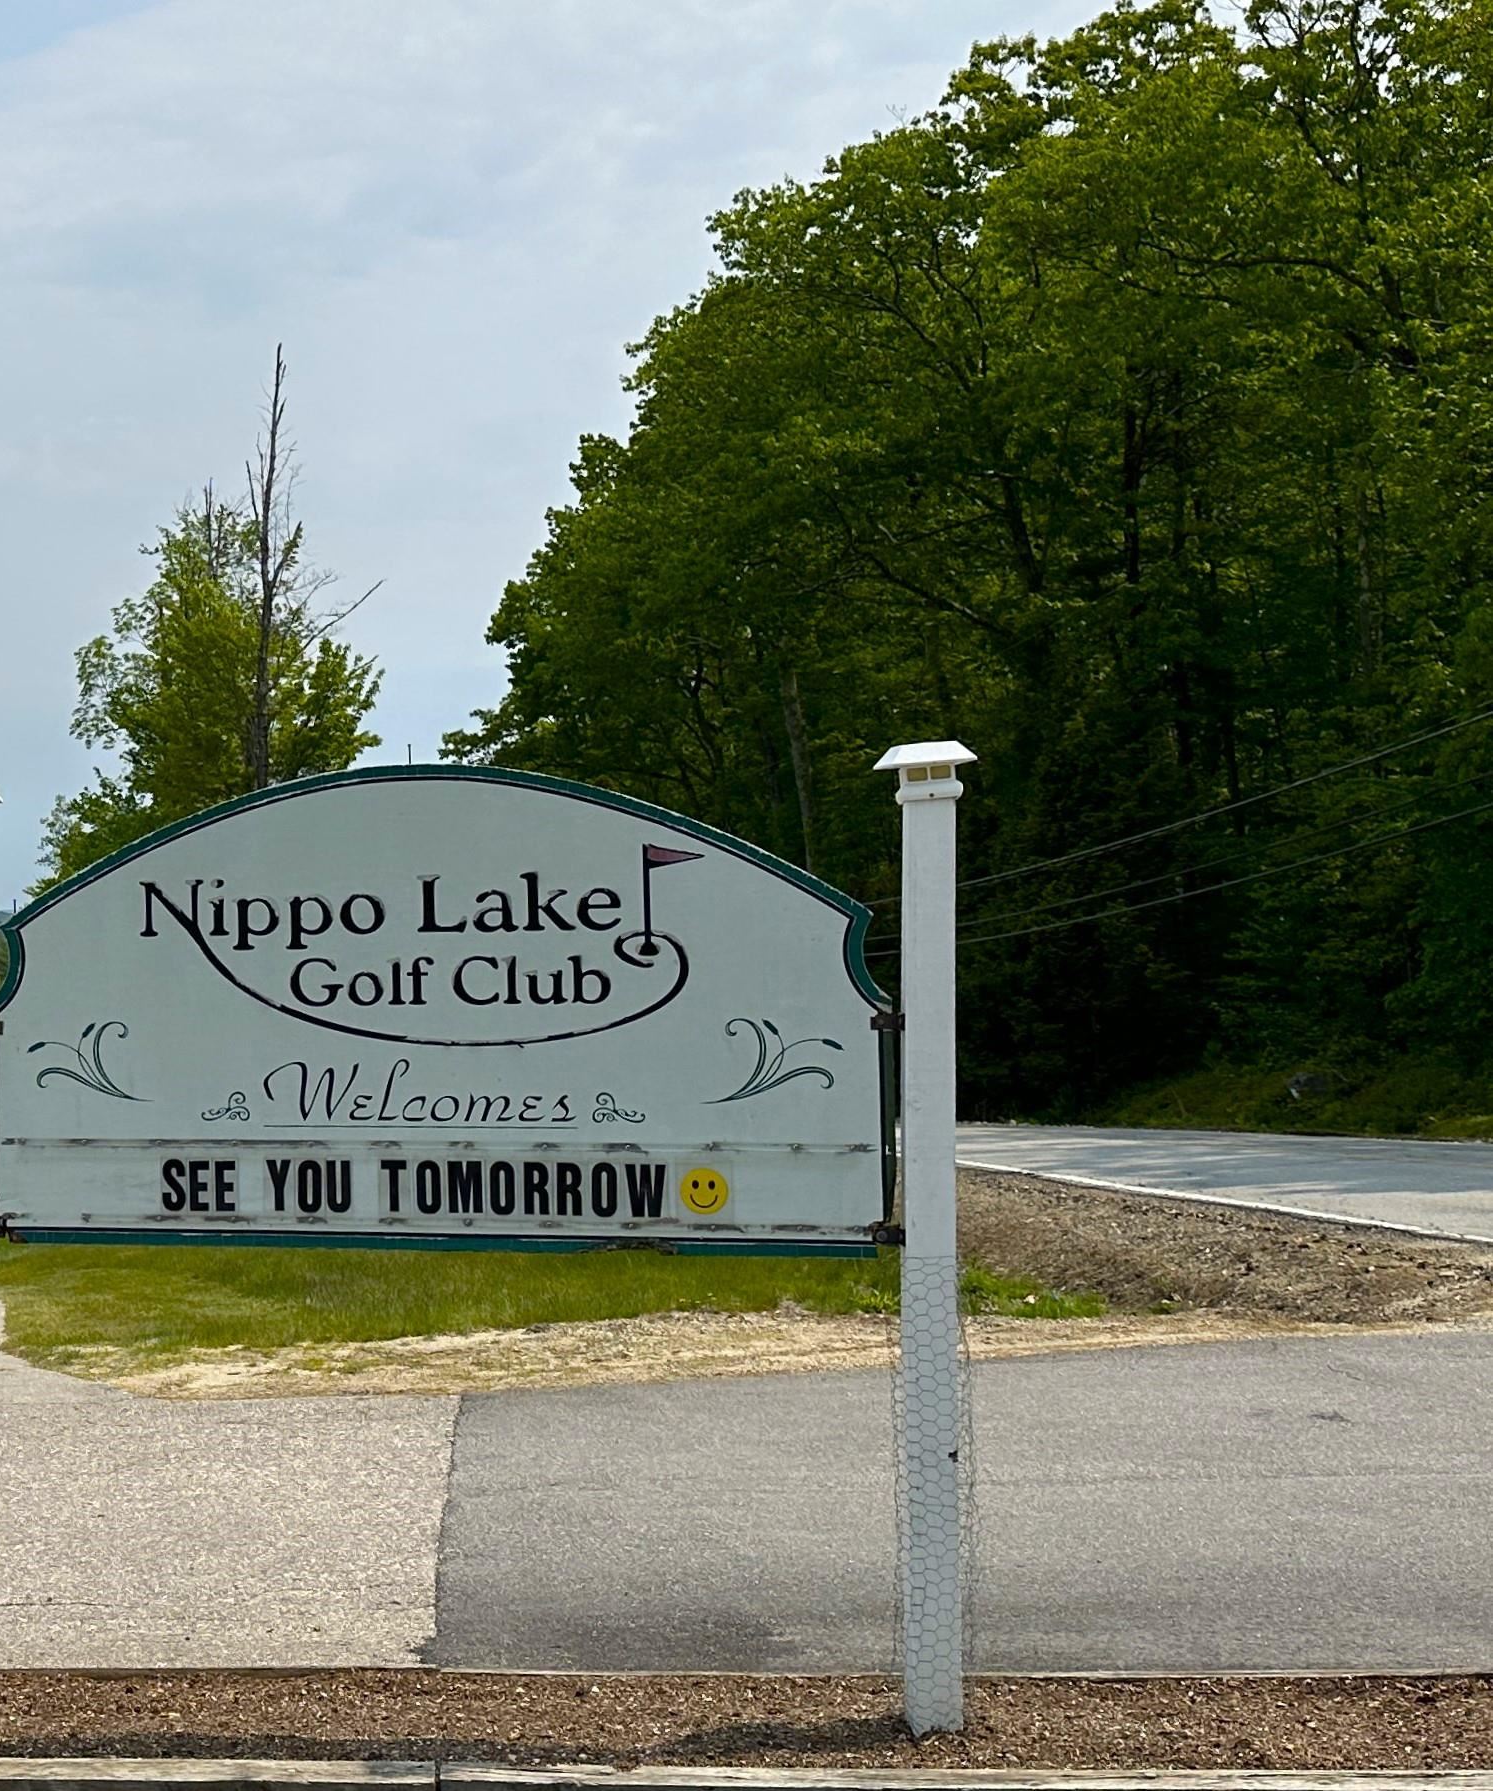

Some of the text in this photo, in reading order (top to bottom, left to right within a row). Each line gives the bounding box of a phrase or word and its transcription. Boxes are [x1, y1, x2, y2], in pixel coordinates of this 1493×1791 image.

[139, 871, 622, 951] Nippo Lake
[289, 955, 613, 1006] Golf Club
[263, 1058, 579, 1123] Welcomes
[161, 1158, 667, 1218] SEE YOU TOMORROW
